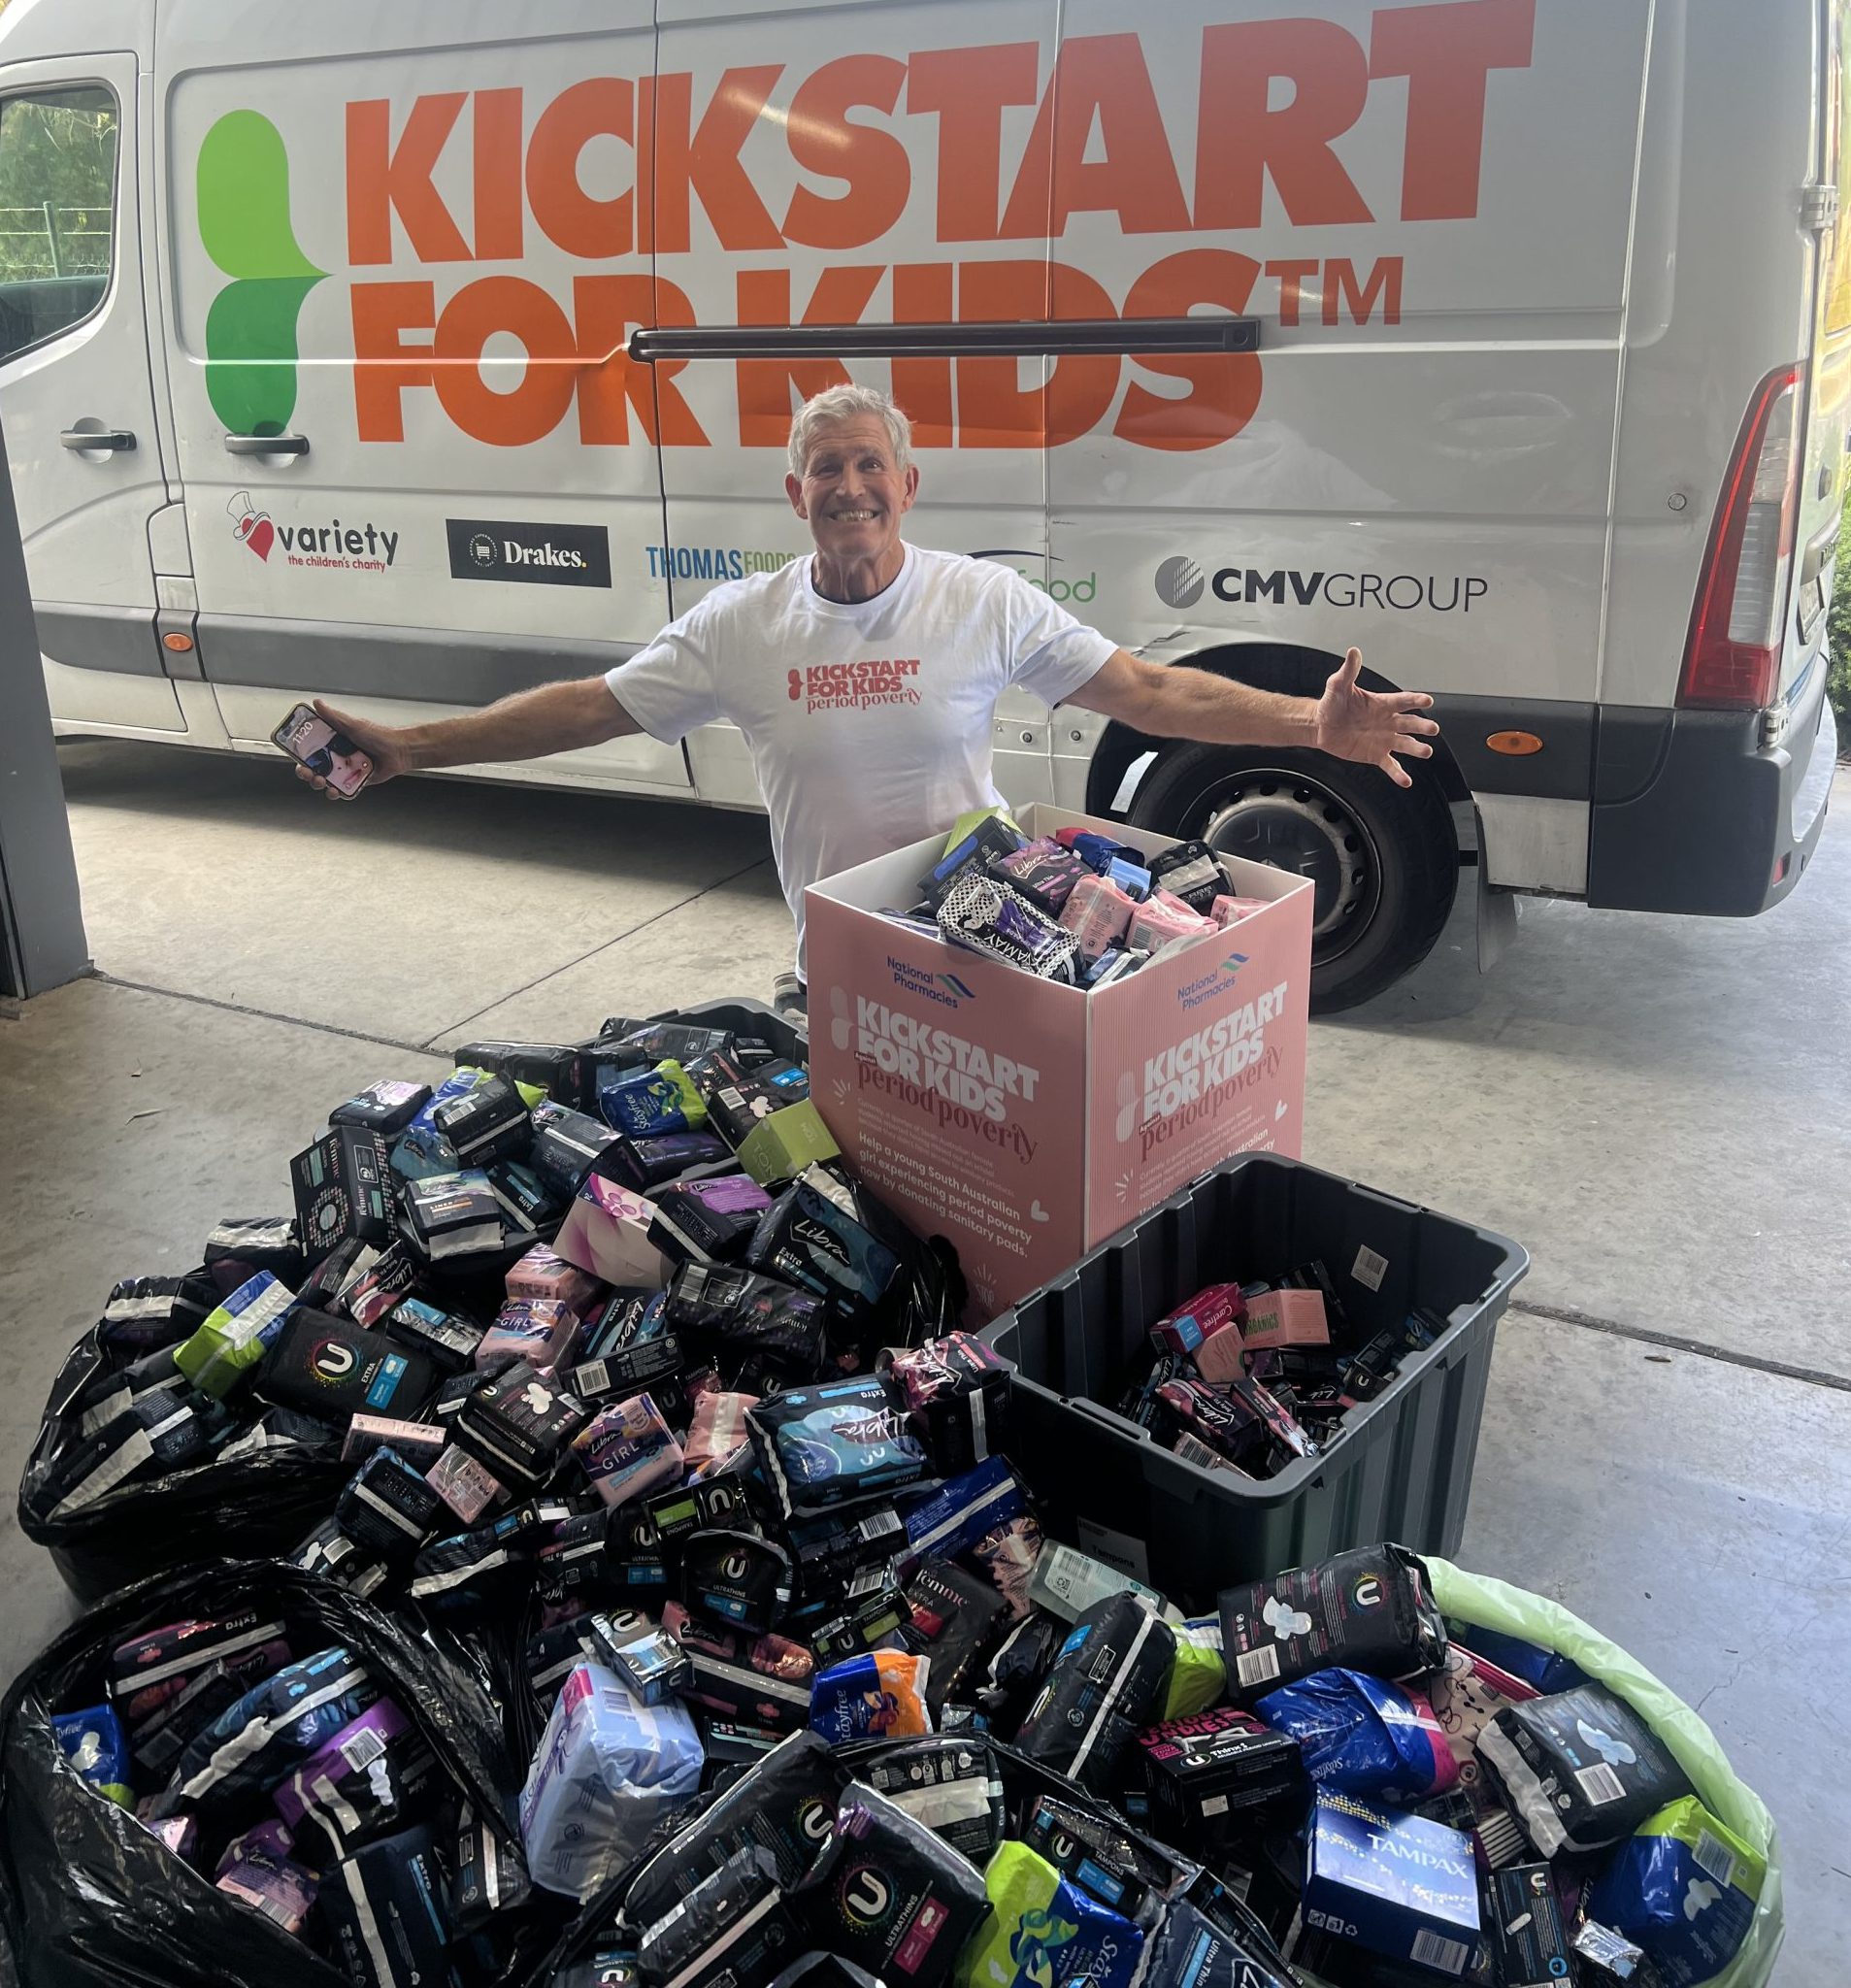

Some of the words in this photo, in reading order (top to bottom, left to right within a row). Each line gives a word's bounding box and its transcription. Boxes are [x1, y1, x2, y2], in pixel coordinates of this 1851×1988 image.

[345, 0, 1537, 266] KICKSTART
[349, 274, 711, 447] FOR
[277, 518, 399, 566] variety
[287, 554, 304, 568] the
[305, 555, 350, 570] children's
[351, 559, 387, 575] charity
[806, 659, 921, 681] KICKSTART
[807, 680, 850, 697] FOR
[852, 677, 903, 695] KIDS
[807, 692, 859, 714] period
[861, 687, 923, 711] poverty
[291, 721, 314, 746] 11:20
[1011, 853, 1049, 876] Libra
[886, 955, 935, 985] National
[893, 974, 959, 1009] Pharmacies
[1177, 970, 1218, 1001] National
[1181, 976, 1237, 1011] Pharmacies
[856, 995, 1040, 1102] KICKSTART
[1143, 981, 1288, 1093] KICKSTART
[858, 1028, 920, 1086] FOR
[925, 1059, 1007, 1122] KIDS
[1143, 1069, 1201, 1123] FOR
[1204, 1028, 1265, 1093] KIDS
[858, 1061, 940, 1115] period
[938, 1104, 1040, 1165] poverty
[1140, 1084, 1215, 1162] period
[1209, 1045, 1284, 1113] poverty
[859, 1131, 882, 1152] Help
[884, 1146, 892, 1156] a
[893, 1150, 926, 1176] young
[927, 1167, 960, 1191] South
[961, 1183, 1021, 1222] Australian
[859, 1149, 876, 1165] girl
[877, 1158, 947, 1203] experiencing
[948, 1193, 984, 1220] period
[986, 1212, 1033, 1245] poverty
[859, 1165, 881, 1182] now
[882, 1174, 897, 1192] by
[897, 1183, 947, 1218] donating
[947, 1209, 996, 1242] sanitary
[996, 1234, 1029, 1259] pads.
[778, 1244, 804, 1266] Extra
[791, 1217, 851, 1266] Libra
[499, 1315, 533, 1328] GIRL
[1203, 1304, 1234, 1330] Carefree
[317, 1342, 353, 1375] U
[360, 1362, 377, 1385] EXTRA
[861, 1389, 887, 1400] Extra
[833, 1409, 901, 1439] Libra
[590, 1428, 622, 1455] Libra
[601, 1442, 641, 1472] GIRL
[726, 1557, 744, 1578] U
[1356, 1580, 1381, 1607] U
[224, 1613, 257, 1633] Extra
[835, 1687, 849, 1745] tayfree
[1056, 1837, 1074, 1859] U
[1366, 1832, 1471, 1880] TAMPAX
[1094, 1850, 1127, 1877] TAMPONS
[847, 1871, 887, 1915] U
[884, 1893, 918, 1948] ULTRATHINS
[1204, 1939, 1221, 1964] Ultra
[1196, 1964, 1212, 1988] Thin
